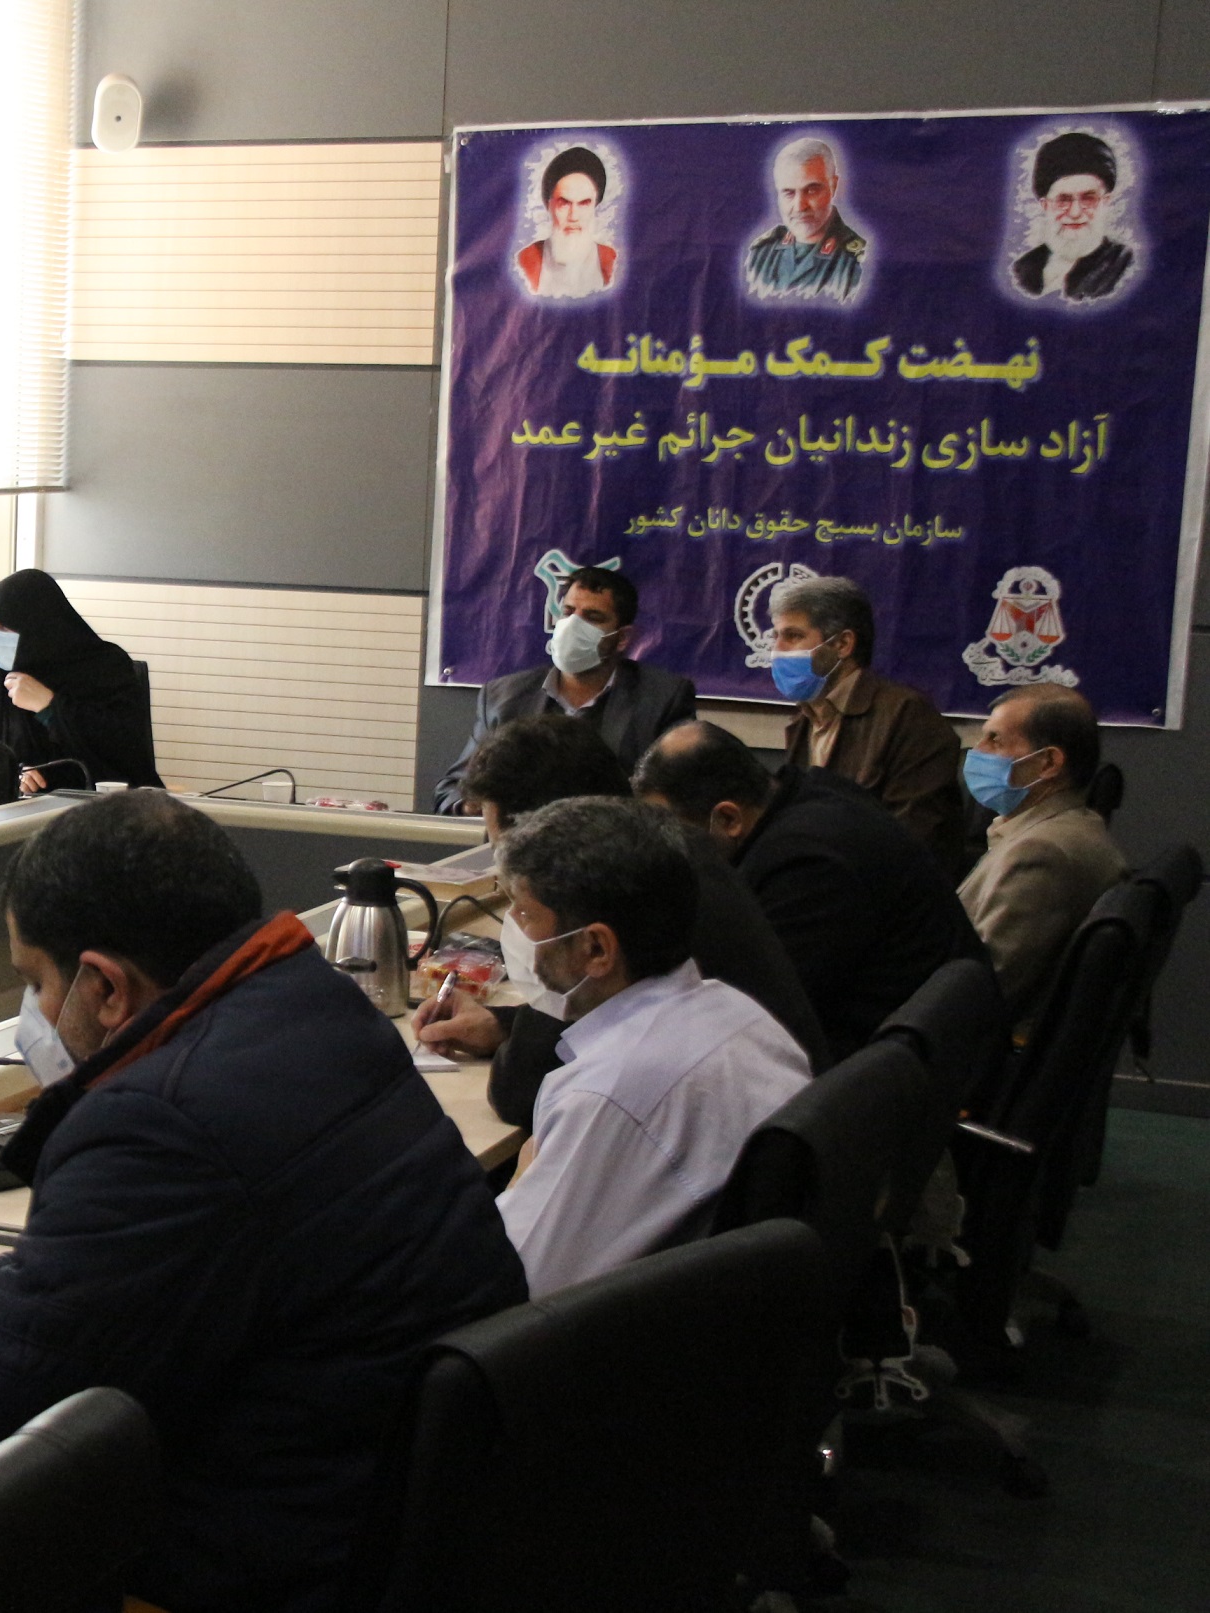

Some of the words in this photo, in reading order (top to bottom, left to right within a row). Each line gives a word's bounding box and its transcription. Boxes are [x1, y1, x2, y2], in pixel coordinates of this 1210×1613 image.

[766, 336, 891, 376] کمک
[899, 339, 1040, 388] نهضت
[511, 419, 582, 445] عمد
[583, 411, 648, 460] غیر
[658, 412, 755, 463] جرائم
[765, 414, 912, 468] زندانیان
[922, 417, 1029, 470] سازی
[1040, 413, 1109, 474] آزاد
[624, 506, 683, 535] کشور
[688, 507, 740, 538] دانان
[746, 509, 810, 540] حقوق
[815, 518, 879, 543] بسیج
[883, 514, 963, 546] سازمان
